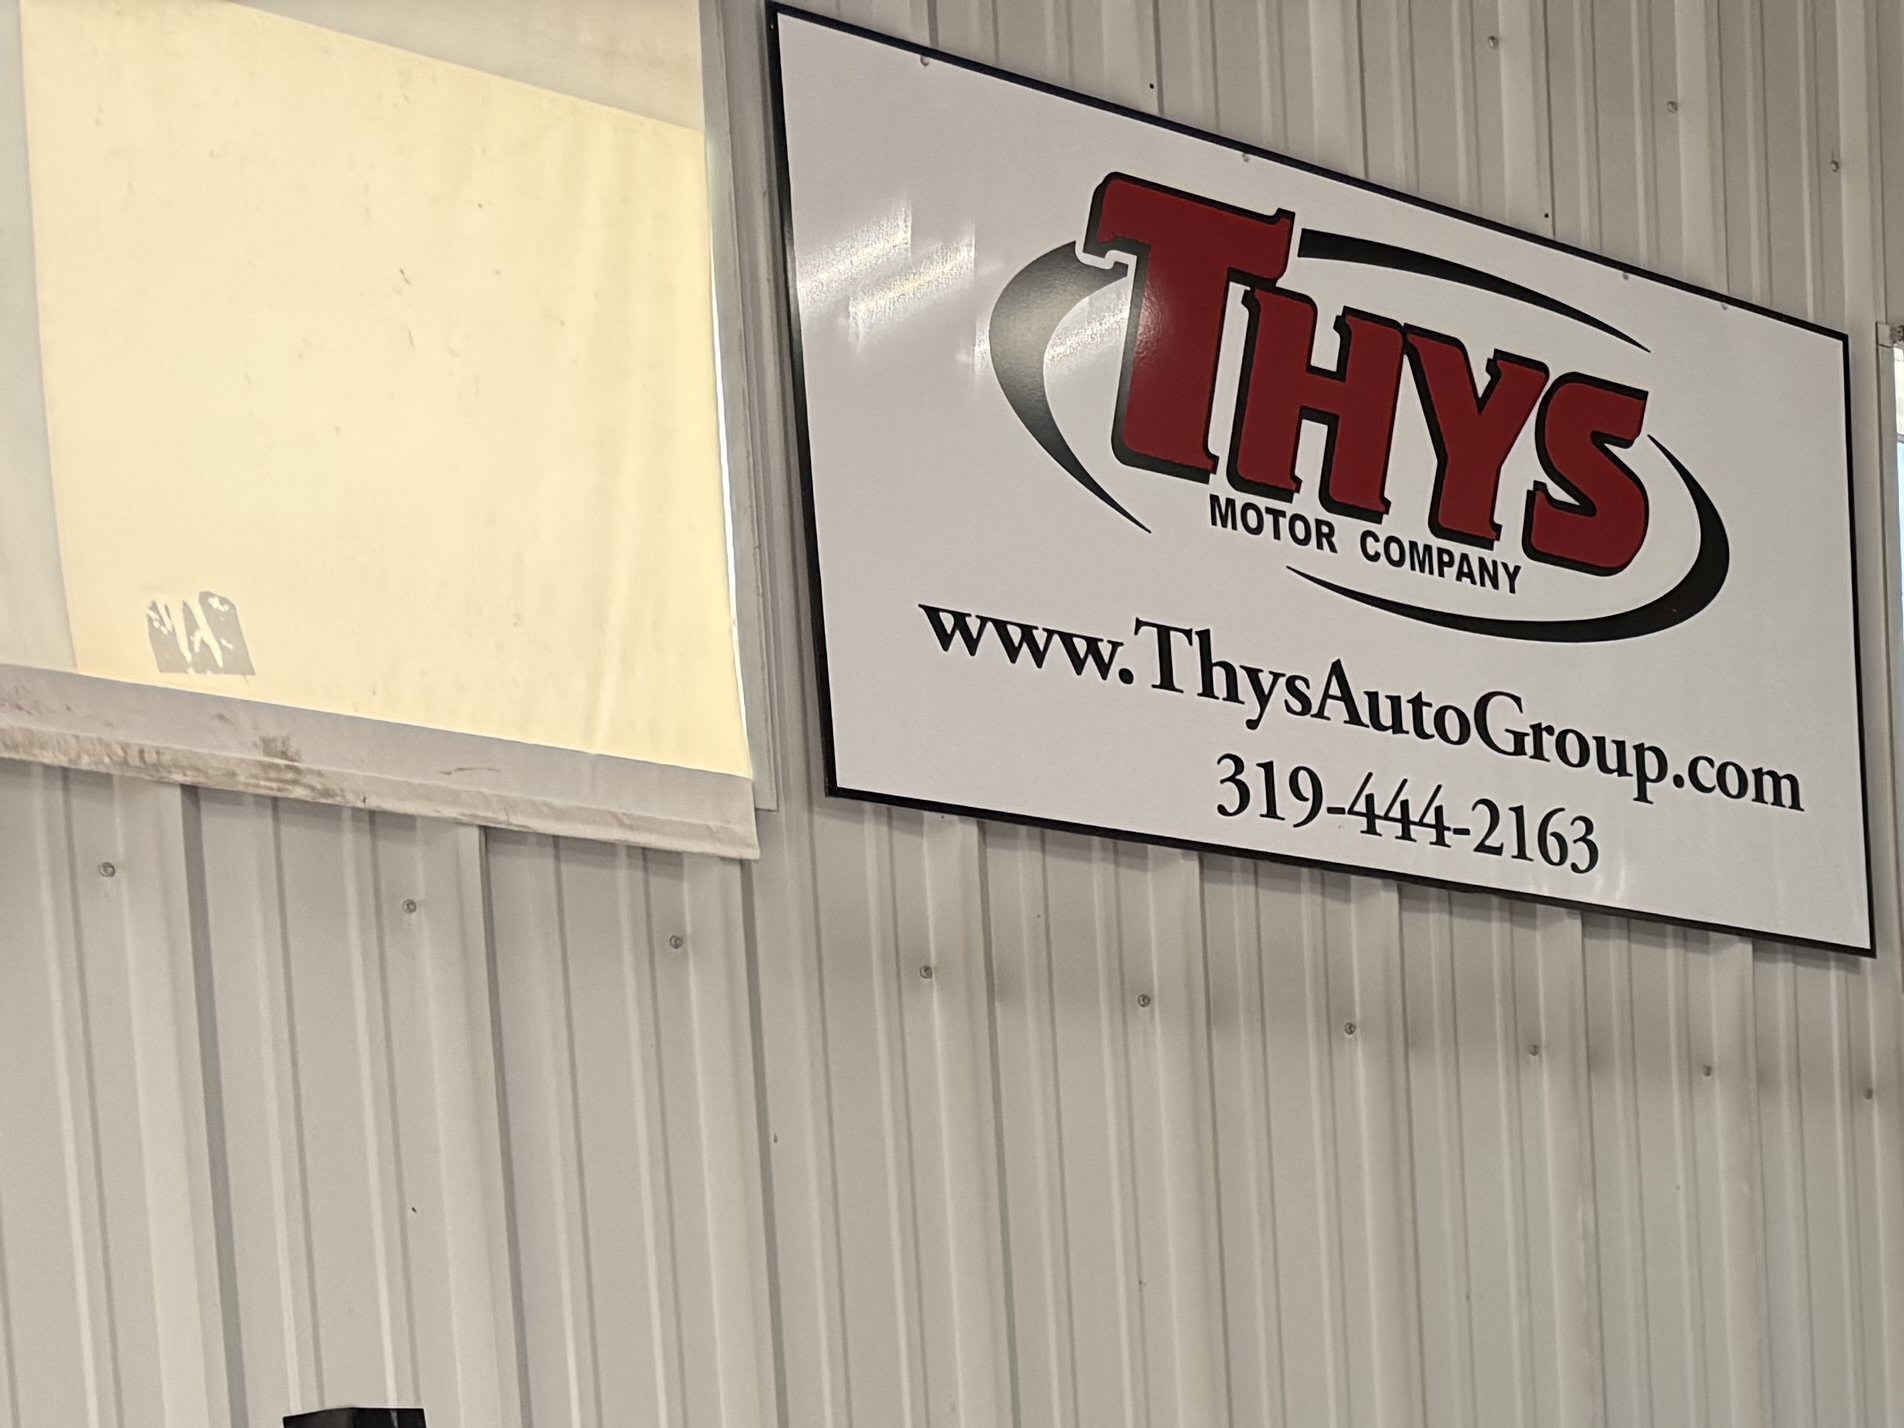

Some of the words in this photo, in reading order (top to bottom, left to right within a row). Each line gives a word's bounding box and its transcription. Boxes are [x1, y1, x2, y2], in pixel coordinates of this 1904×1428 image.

[1085, 171, 1649, 576] THYS
[1209, 493, 1337, 555] MOTOR
[1359, 529, 1522, 596] COMPANY
[918, 602, 1805, 814] www.ThysAutoGroup.com
[1215, 752, 1601, 877] 319-444-2163
